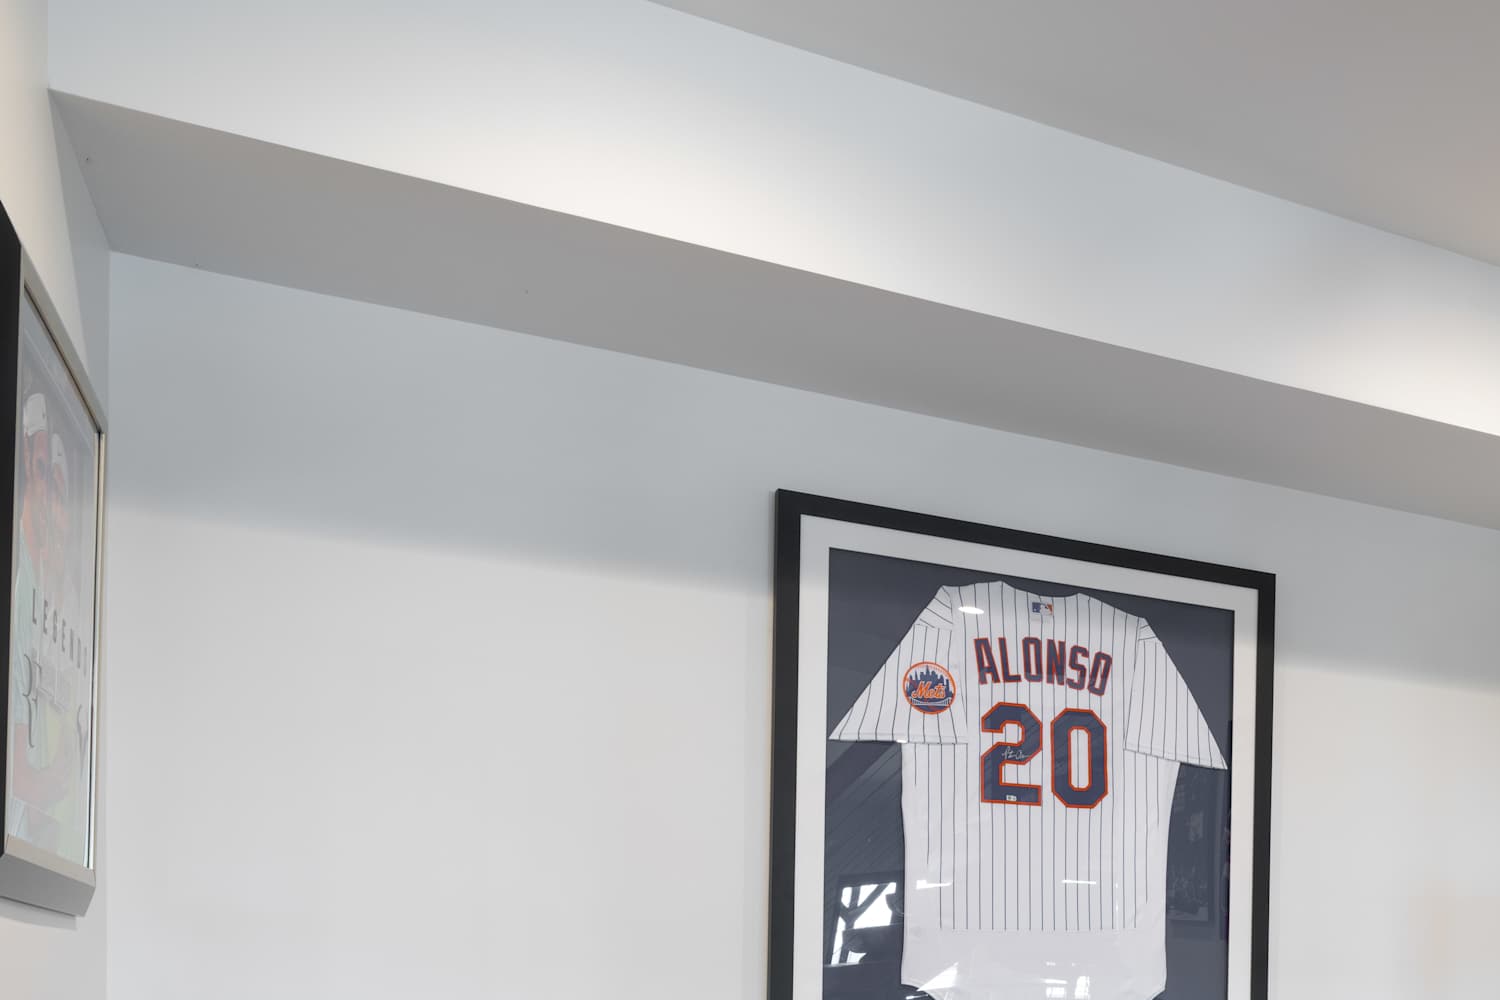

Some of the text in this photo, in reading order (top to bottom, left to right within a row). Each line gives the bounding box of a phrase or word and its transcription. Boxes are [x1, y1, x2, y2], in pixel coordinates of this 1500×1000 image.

[911, 681, 945, 699] Mets
[973, 636, 1113, 697] ALONSO
[980, 701, 1109, 809] 20
